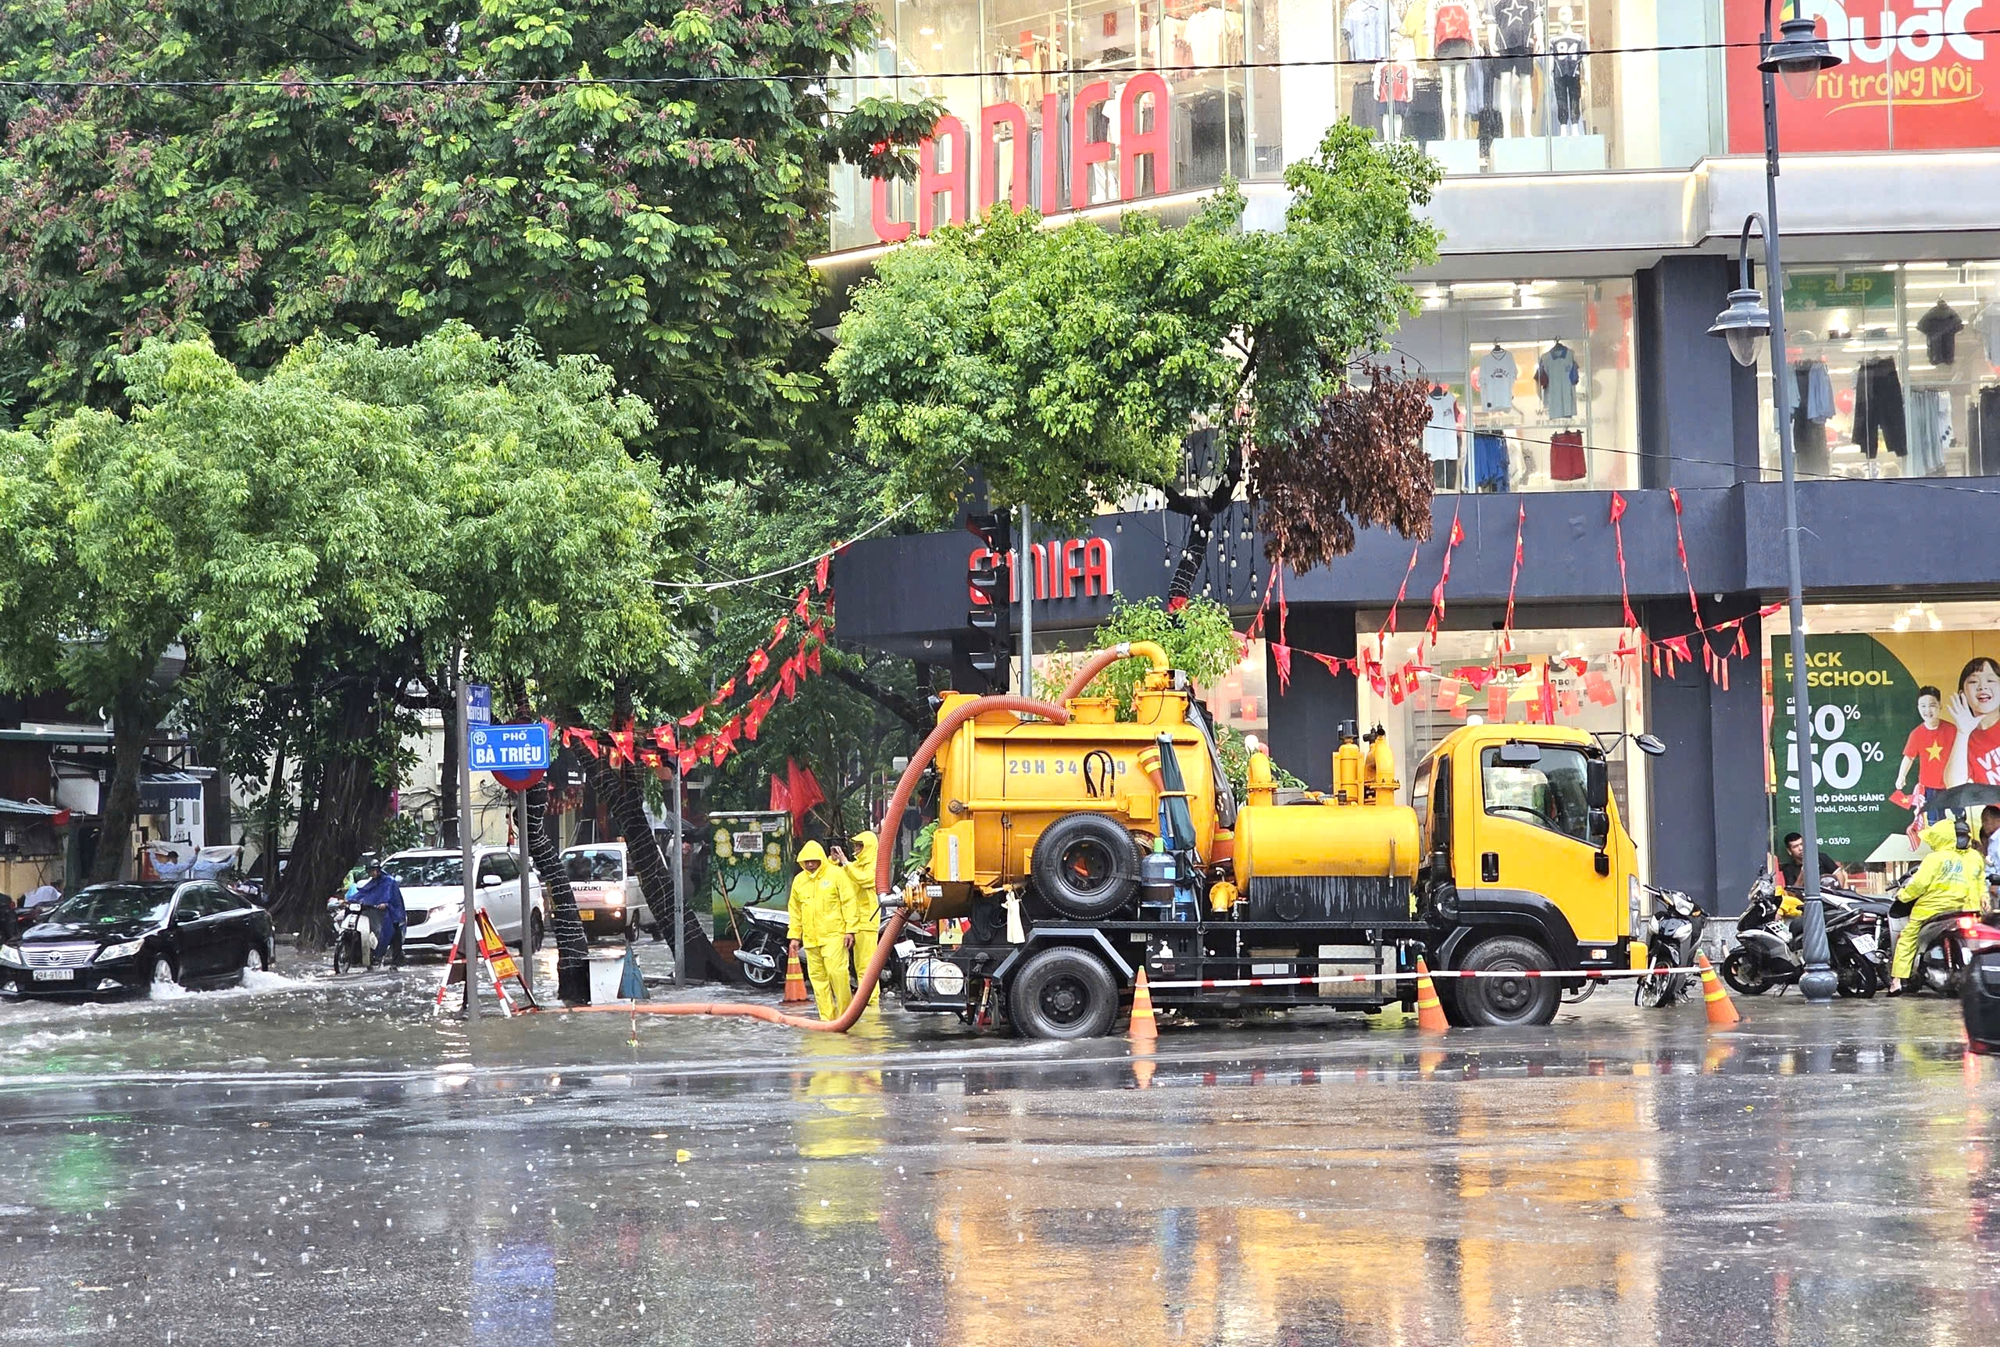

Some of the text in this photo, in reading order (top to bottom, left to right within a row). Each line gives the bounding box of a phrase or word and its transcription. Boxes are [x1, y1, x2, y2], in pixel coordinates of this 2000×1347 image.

[872, 72, 1172, 242] CANIFA
[1806, 670, 1894, 687] SCHOOL
[502, 729, 528, 741] PHỐ
[475, 743, 542, 765] BÀ TRIỆU
[1009, 760, 1045, 774] 29H
[1784, 741, 1884, 791] 50%
[1816, 793, 1830, 804] BỘ
[1831, 793, 1858, 803] DÒNG
[1859, 792, 1886, 803] HÀNG
[1839, 805, 1857, 813] Polo,
[1869, 804, 1880, 812] mi
[1829, 837, 1851, 846] 03/09
